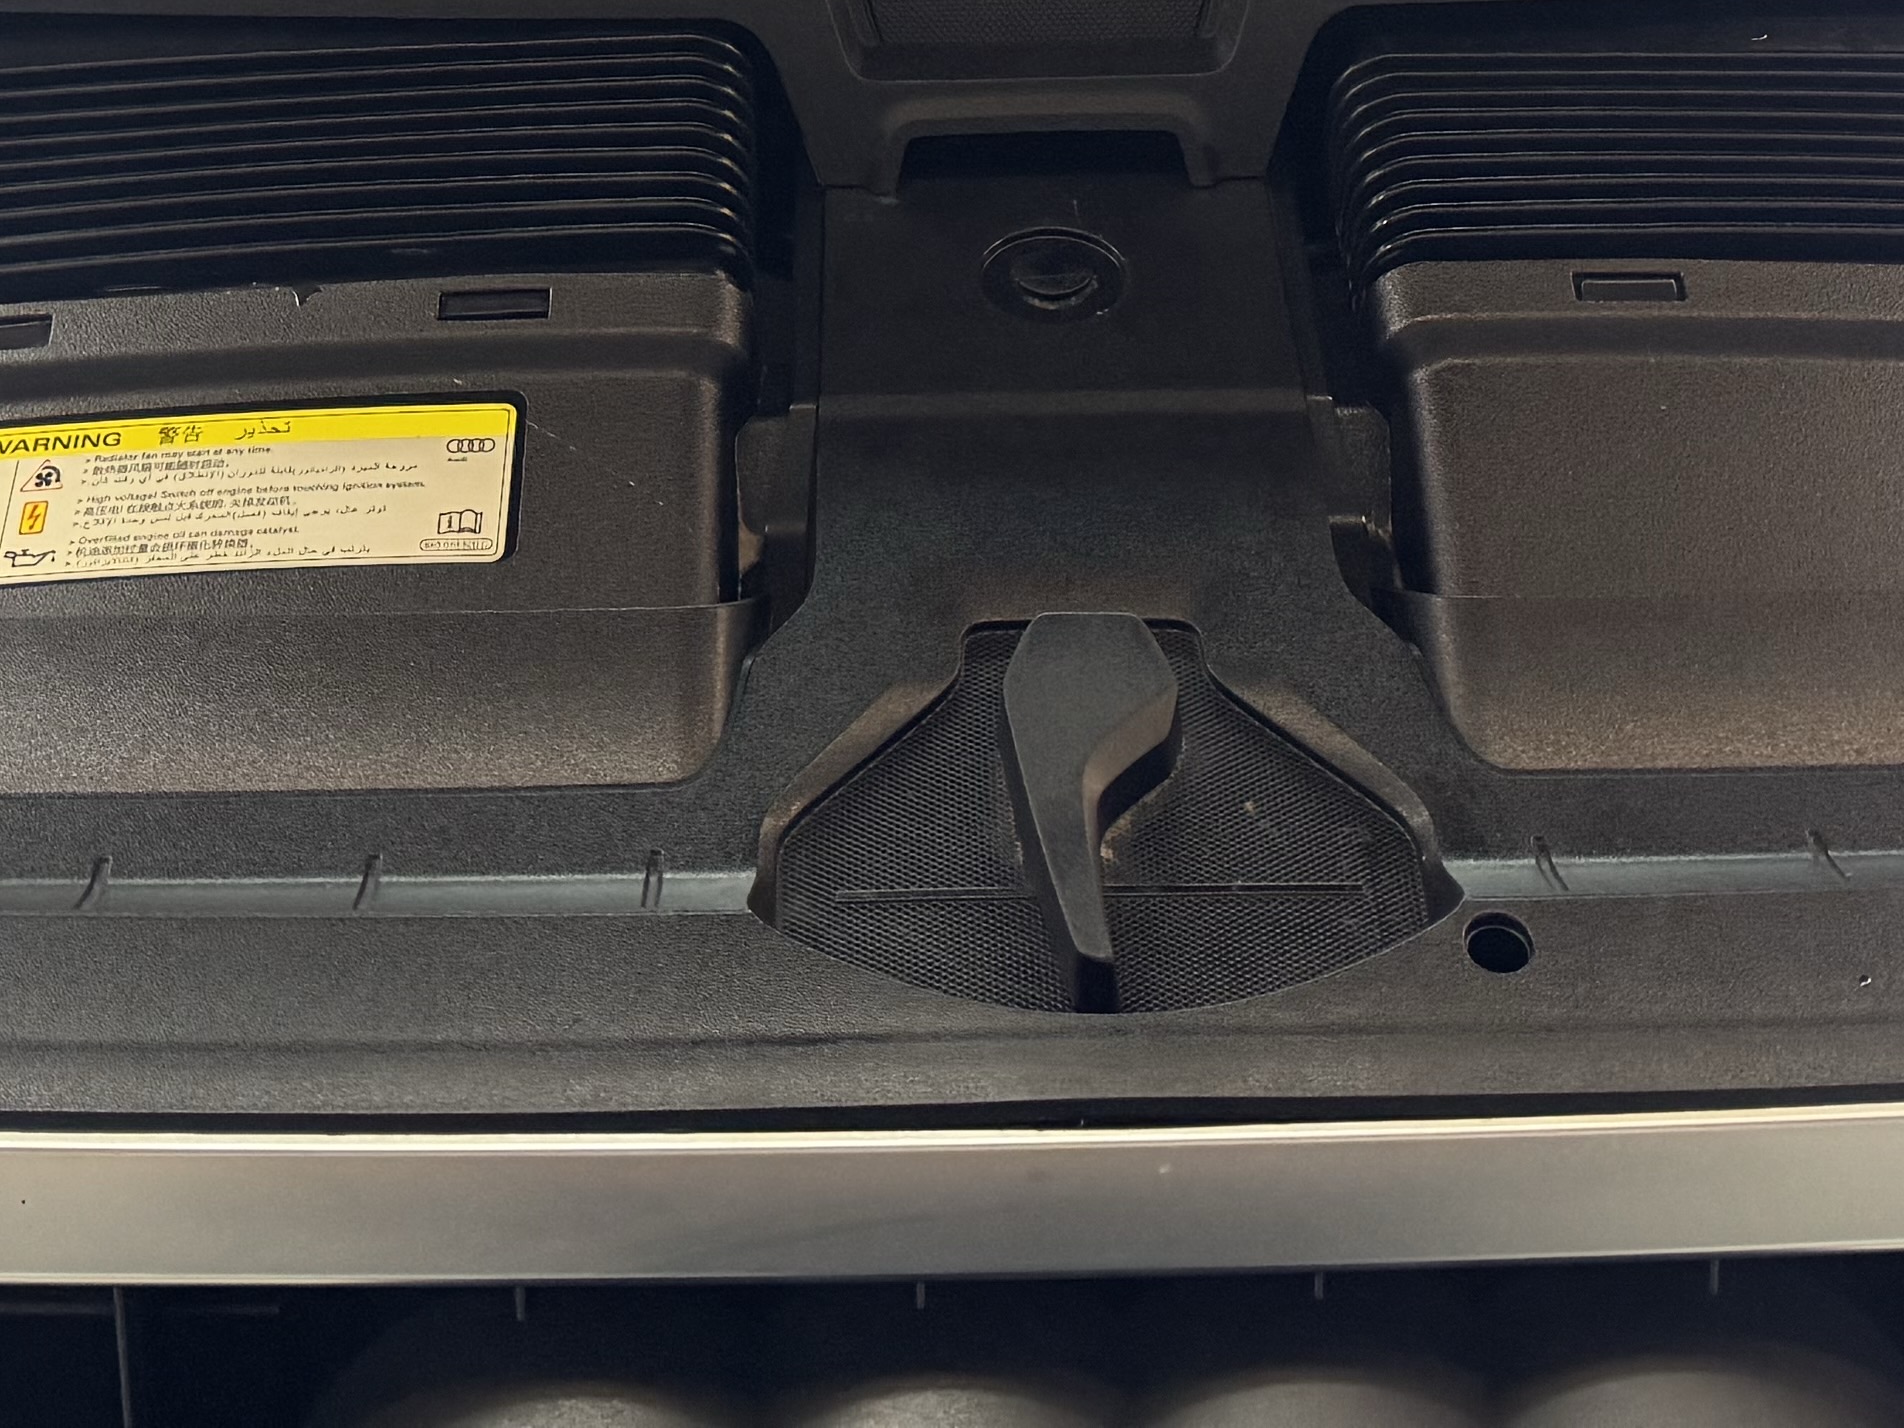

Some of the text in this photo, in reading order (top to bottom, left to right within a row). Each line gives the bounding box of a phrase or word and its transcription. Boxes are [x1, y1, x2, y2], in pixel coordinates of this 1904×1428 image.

[158, 425, 203, 445] 警告
[234, 420, 291, 441] تحذير
[217, 486, 253, 496] engine
